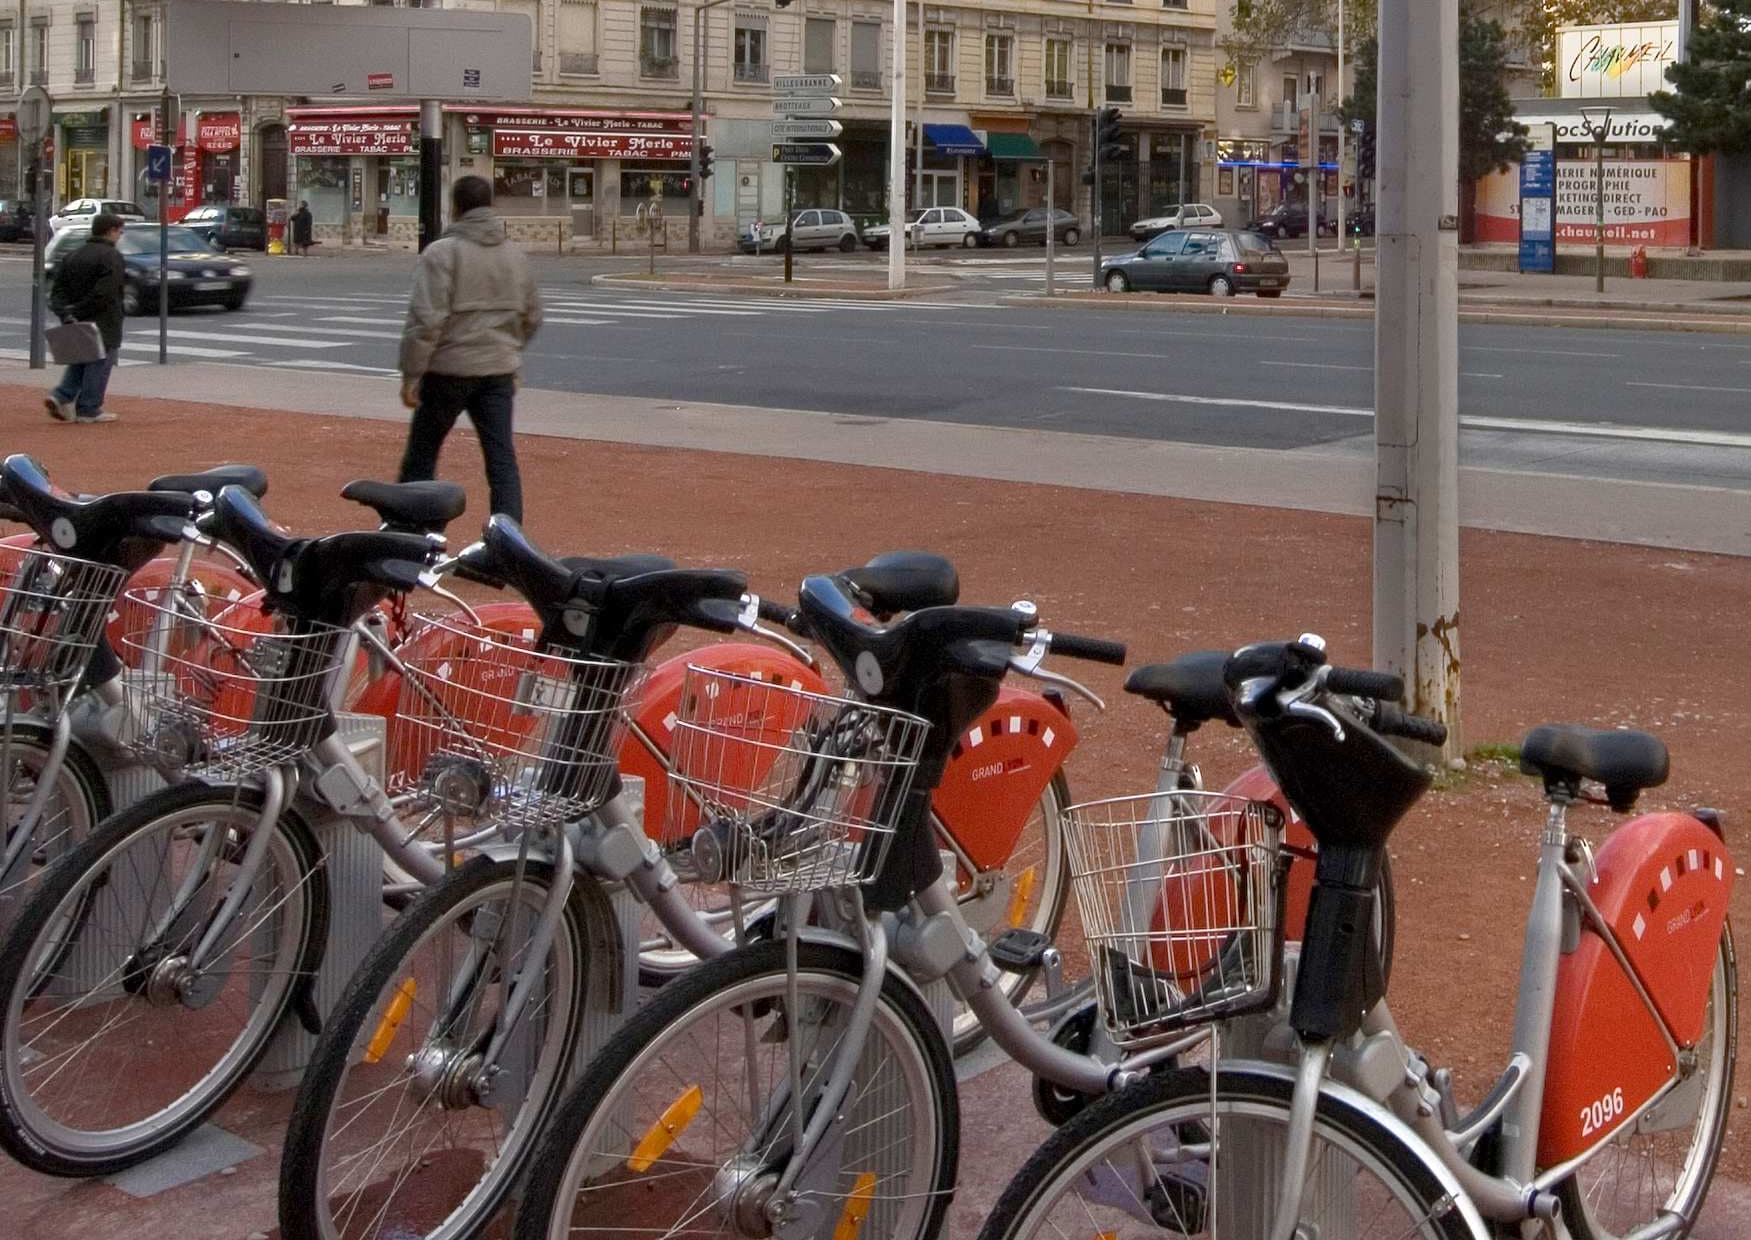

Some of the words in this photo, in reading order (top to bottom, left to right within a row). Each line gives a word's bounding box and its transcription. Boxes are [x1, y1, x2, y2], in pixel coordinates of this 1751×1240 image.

[497, 117, 548, 126] BRASSERIE
[555, 117, 569, 127] Le
[571, 118, 601, 127] Vivier
[603, 119, 630, 129] Merle
[637, 121, 664, 129] TABAC
[1557, 118, 1664, 137] ocSolution
[309, 133, 325, 145] Le
[332, 133, 367, 145] Vivier
[374, 133, 407, 146] Merle
[529, 135, 553, 147] Le
[564, 136, 618, 148] Vivier
[628, 137, 674, 150] Merle
[295, 145, 341, 153] BRASSERIE
[360, 145, 388, 153] TABAC
[503, 147, 579, 156] BRASSERIE
[608, 149, 648, 157] TABAC
[1559, 181, 1630, 191] PROGRPHIE
[1559, 193, 1599, 203] KETING
[1604, 194, 1642, 203] DIRECT
[972, 761, 1004, 782] GRAND
[1580, 1086, 1624, 1137] 2096
